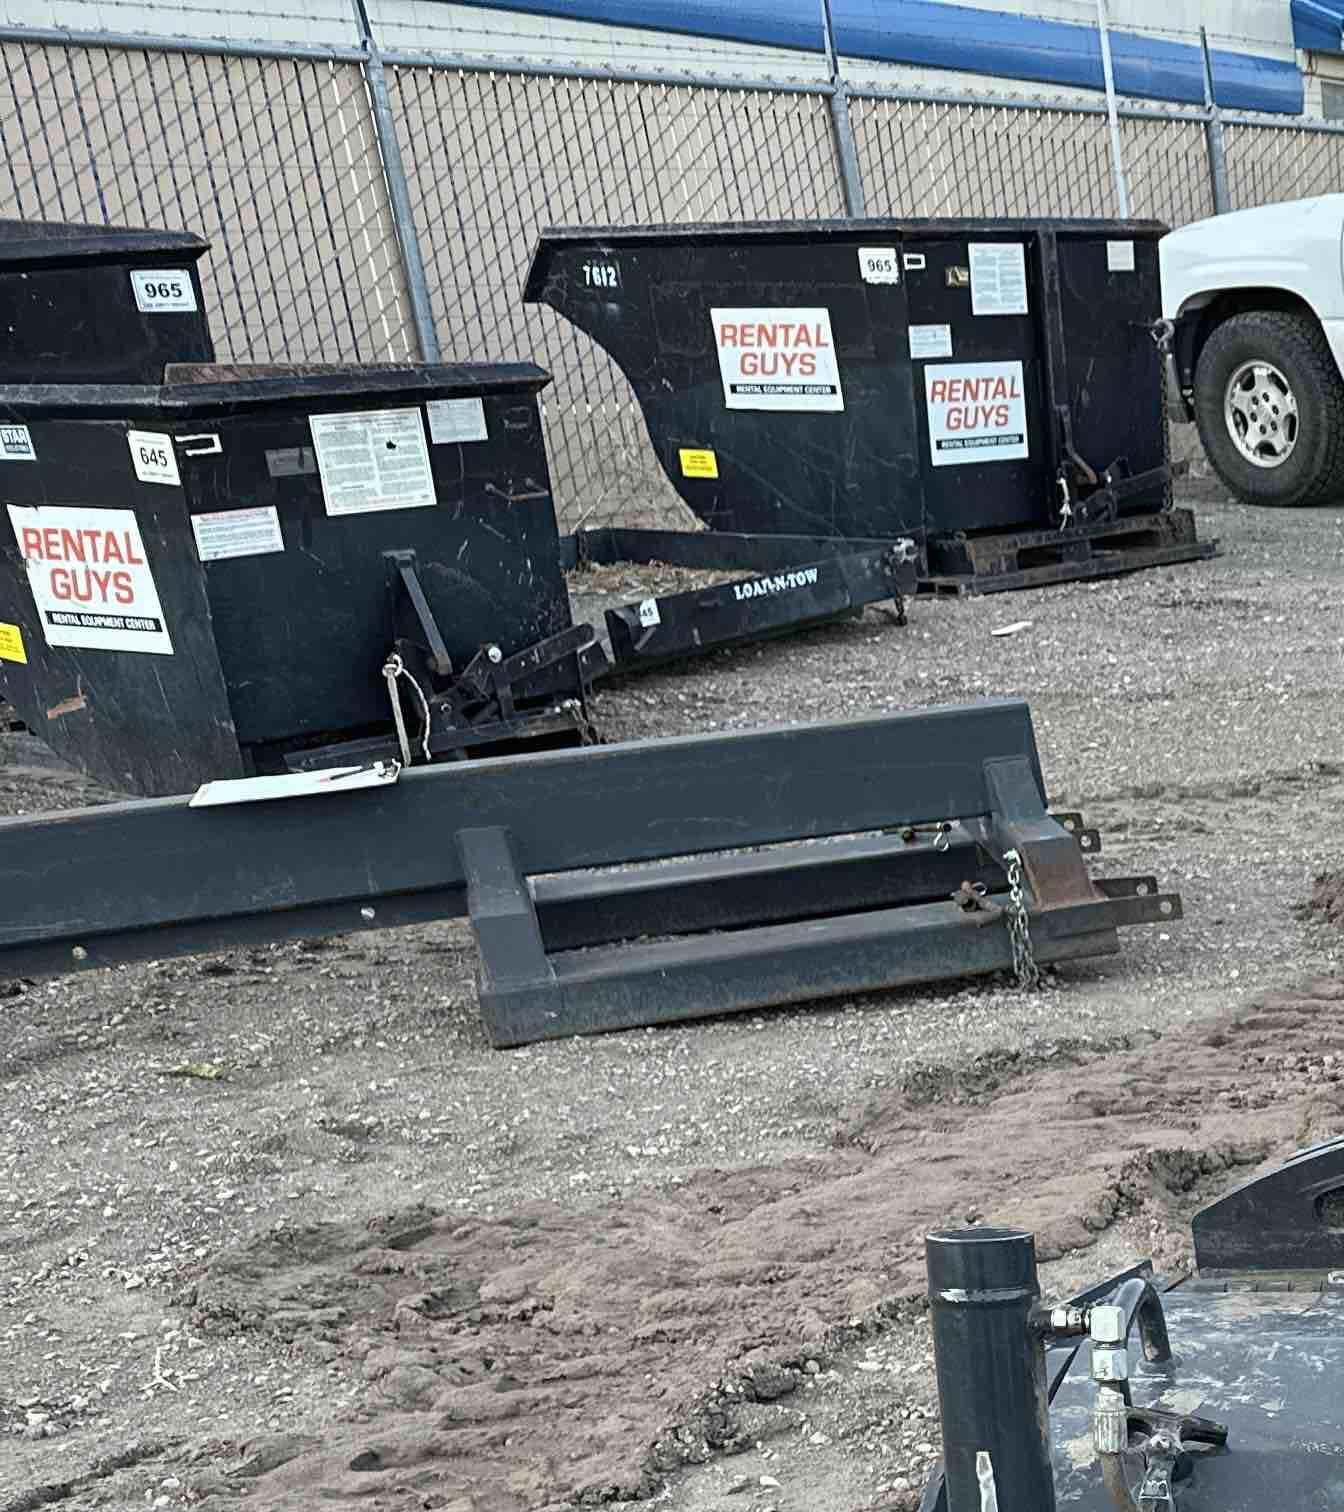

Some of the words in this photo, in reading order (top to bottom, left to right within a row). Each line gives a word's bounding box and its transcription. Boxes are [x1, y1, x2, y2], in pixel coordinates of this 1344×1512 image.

[866, 258, 892, 273] 965
[144, 282, 183, 299] 965
[720, 323, 830, 348] RENTAL
[740, 352, 817, 377] GUYS
[930, 376, 1021, 404] RENTAL
[945, 404, 1010, 431] GUYS
[140, 447, 168, 467] 645
[22, 527, 144, 565] RENTAL
[50, 567, 135, 604] GUYS
